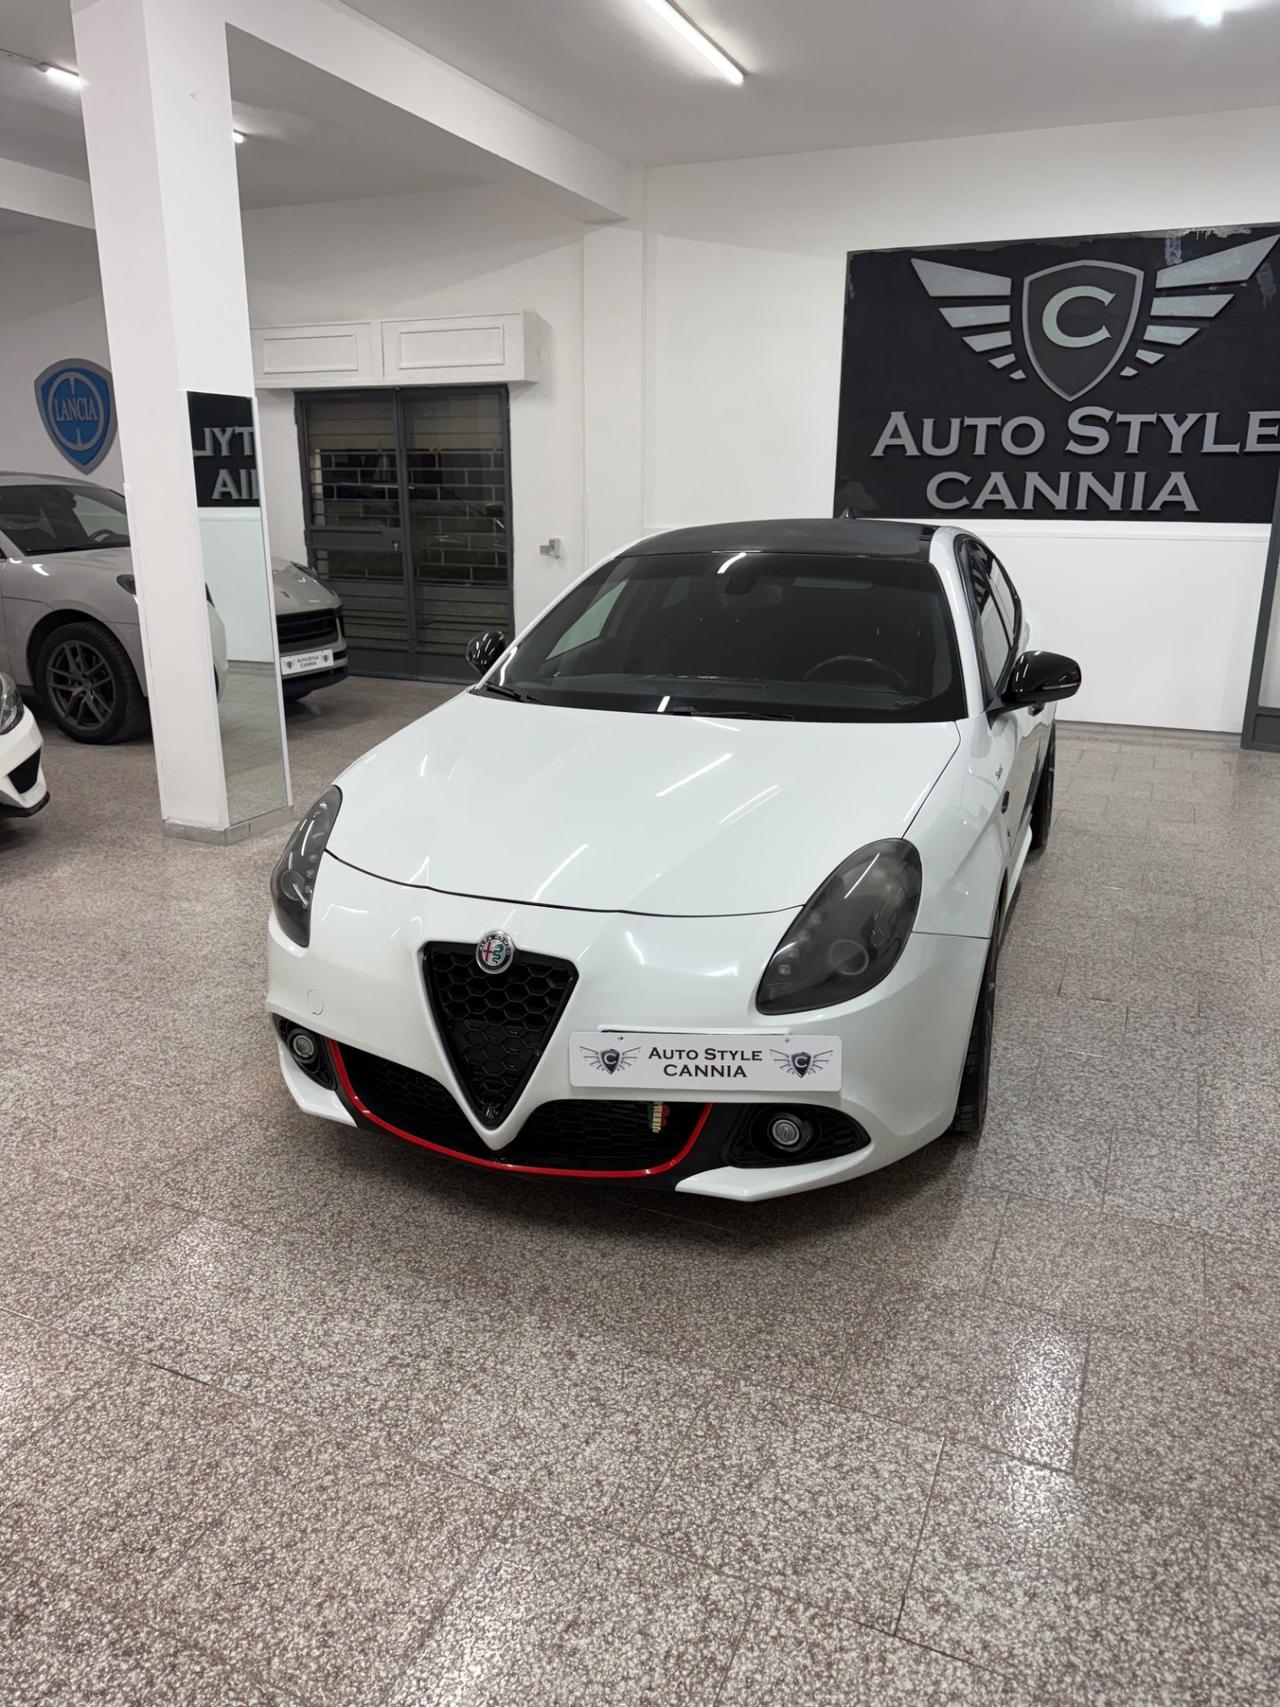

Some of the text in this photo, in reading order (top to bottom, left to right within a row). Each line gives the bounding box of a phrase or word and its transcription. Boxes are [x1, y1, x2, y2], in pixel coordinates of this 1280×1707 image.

[1042, 286, 1115, 348] C
[54, 398, 98, 421] LANCIA
[871, 406, 1280, 456] AUTO STYLE
[927, 471, 1199, 511] CANNIA
[648, 1046, 762, 1061] AUTO STYLE
[663, 1065, 747, 1078] CANNIA
